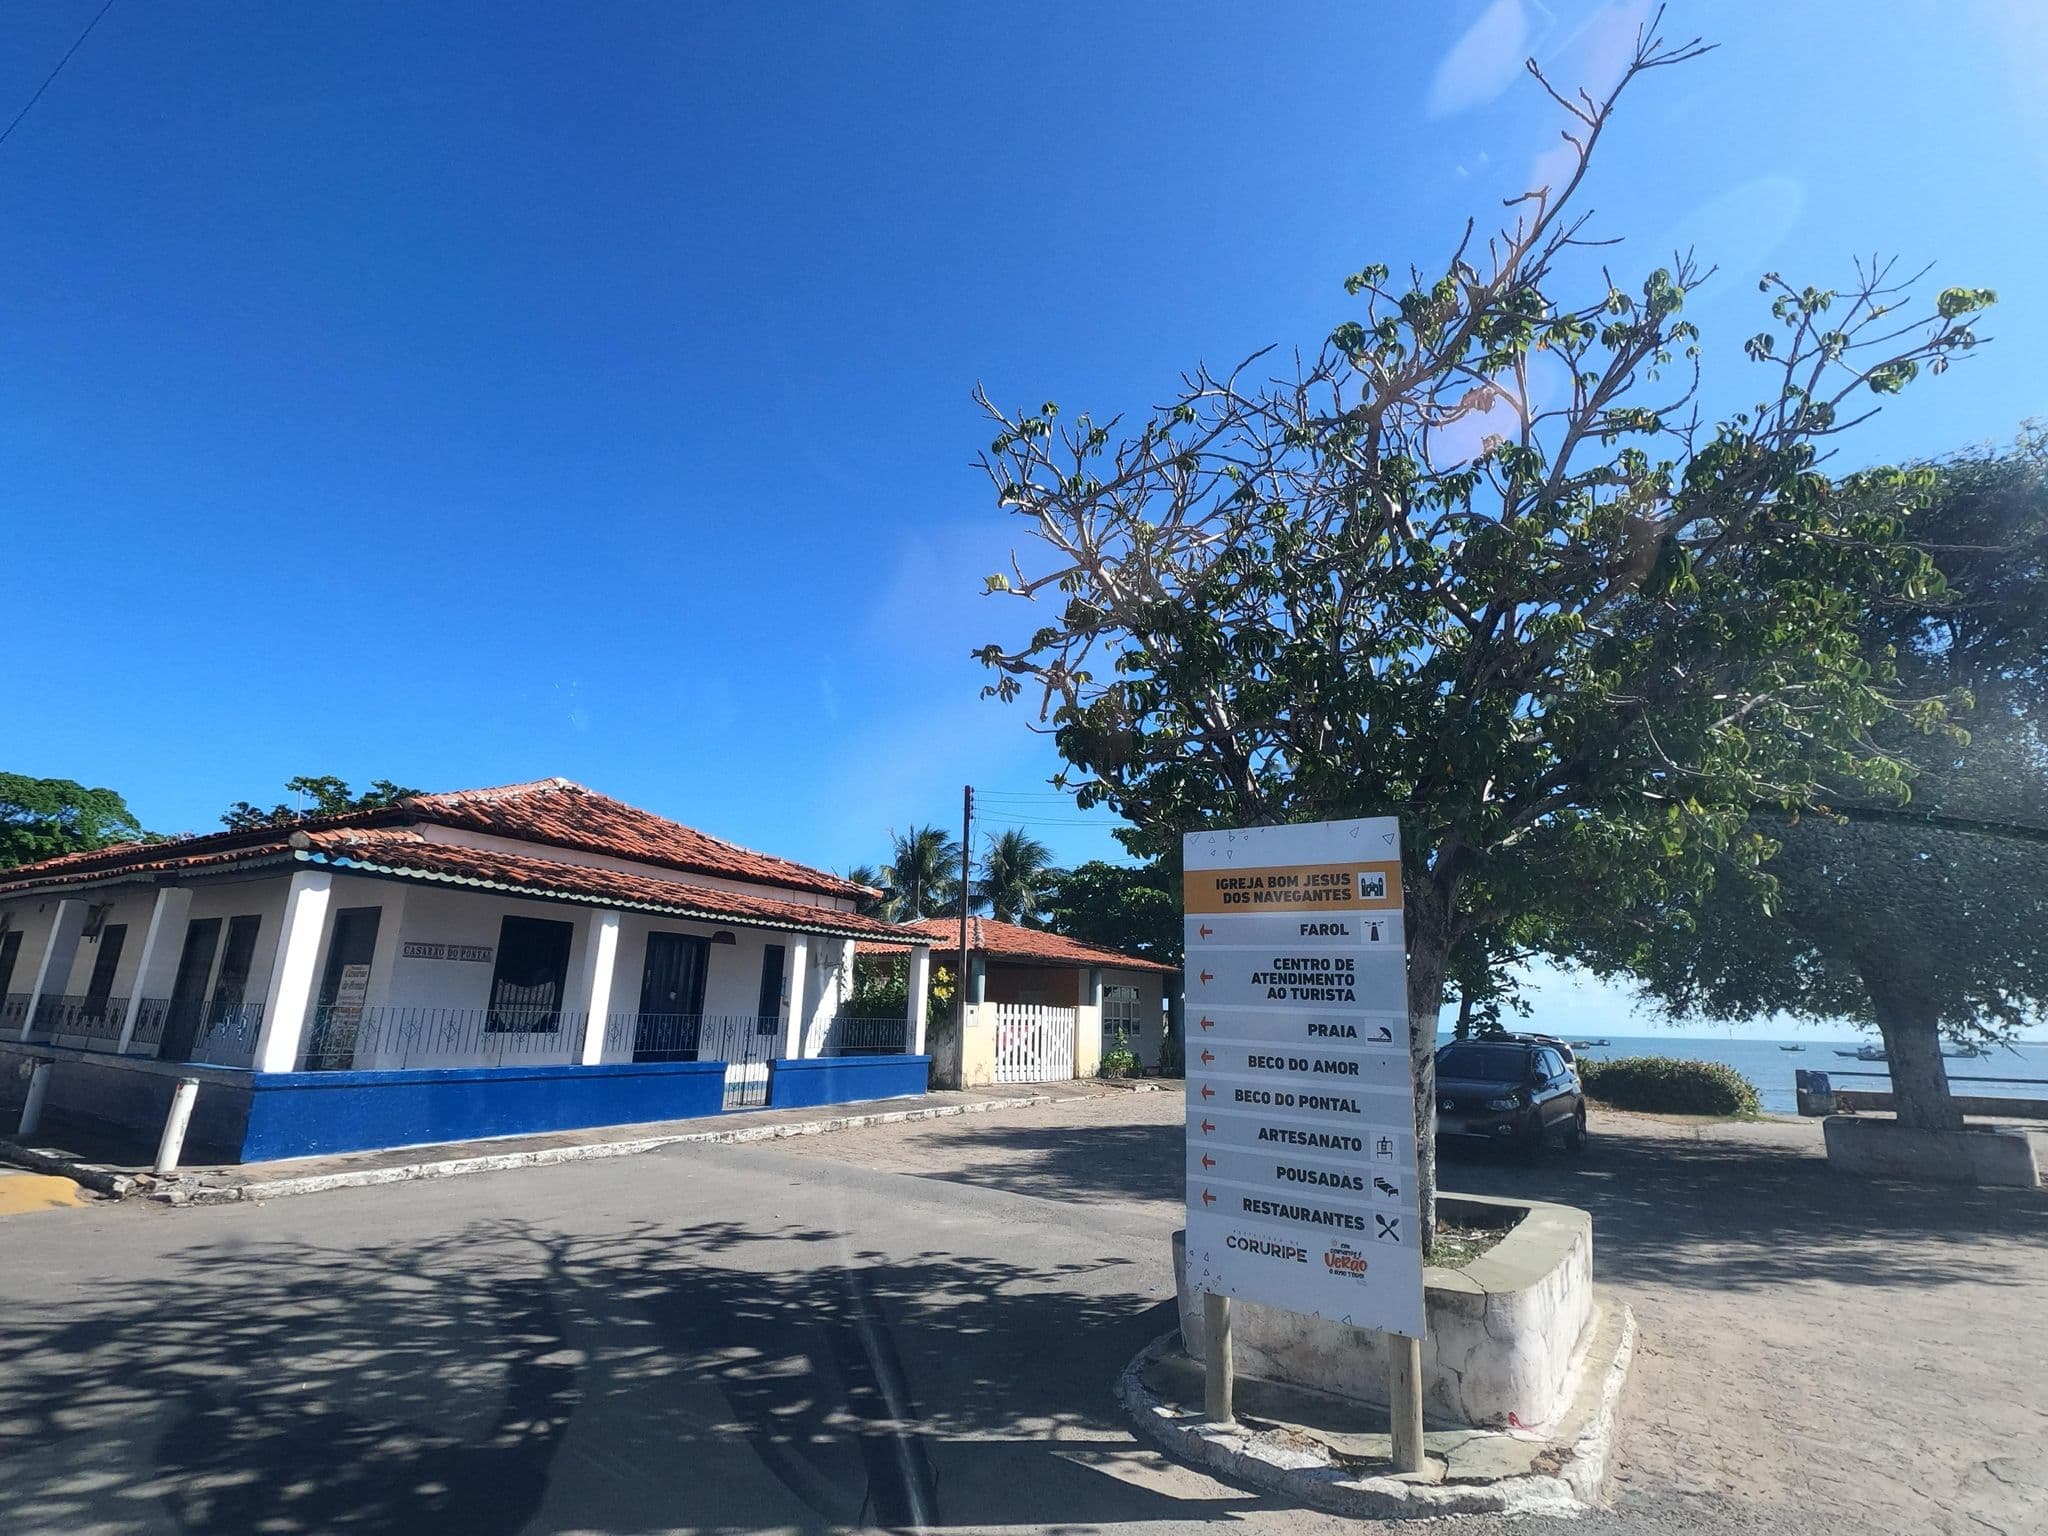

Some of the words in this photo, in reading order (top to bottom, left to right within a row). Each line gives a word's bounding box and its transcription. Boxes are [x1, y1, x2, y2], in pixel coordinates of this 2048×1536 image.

[1215, 876, 1264, 891] IGREJA
[1267, 875, 1298, 889] BOM
[1302, 873, 1351, 887] JESUS
[1223, 891, 1250, 905] DOS
[1253, 887, 1352, 904] NAVEGANTES
[1299, 923, 1350, 937] FAROL
[1273, 957, 1331, 971] CENTRO
[1334, 958, 1355, 972] DE
[1251, 972, 1355, 987] ATENDIMENTO
[1267, 986, 1287, 1000] AO
[1290, 987, 1356, 1002] TURISTA
[1307, 1023, 1358, 1039] PRAIA
[1248, 1055, 1285, 1070] BECO
[1288, 1057, 1309, 1072] DO
[1312, 1059, 1360, 1076] AMOR
[1234, 1088, 1271, 1104] BECO
[1274, 1092, 1295, 1107] DO
[1298, 1095, 1361, 1114] PONTAL
[1258, 1127, 1362, 1152] ARTESANATO
[1276, 1166, 1364, 1192] POUSADAS
[1243, 1197, 1365, 1231] RESTAURANTES
[1226, 1235, 1308, 1264] CORURIPE
